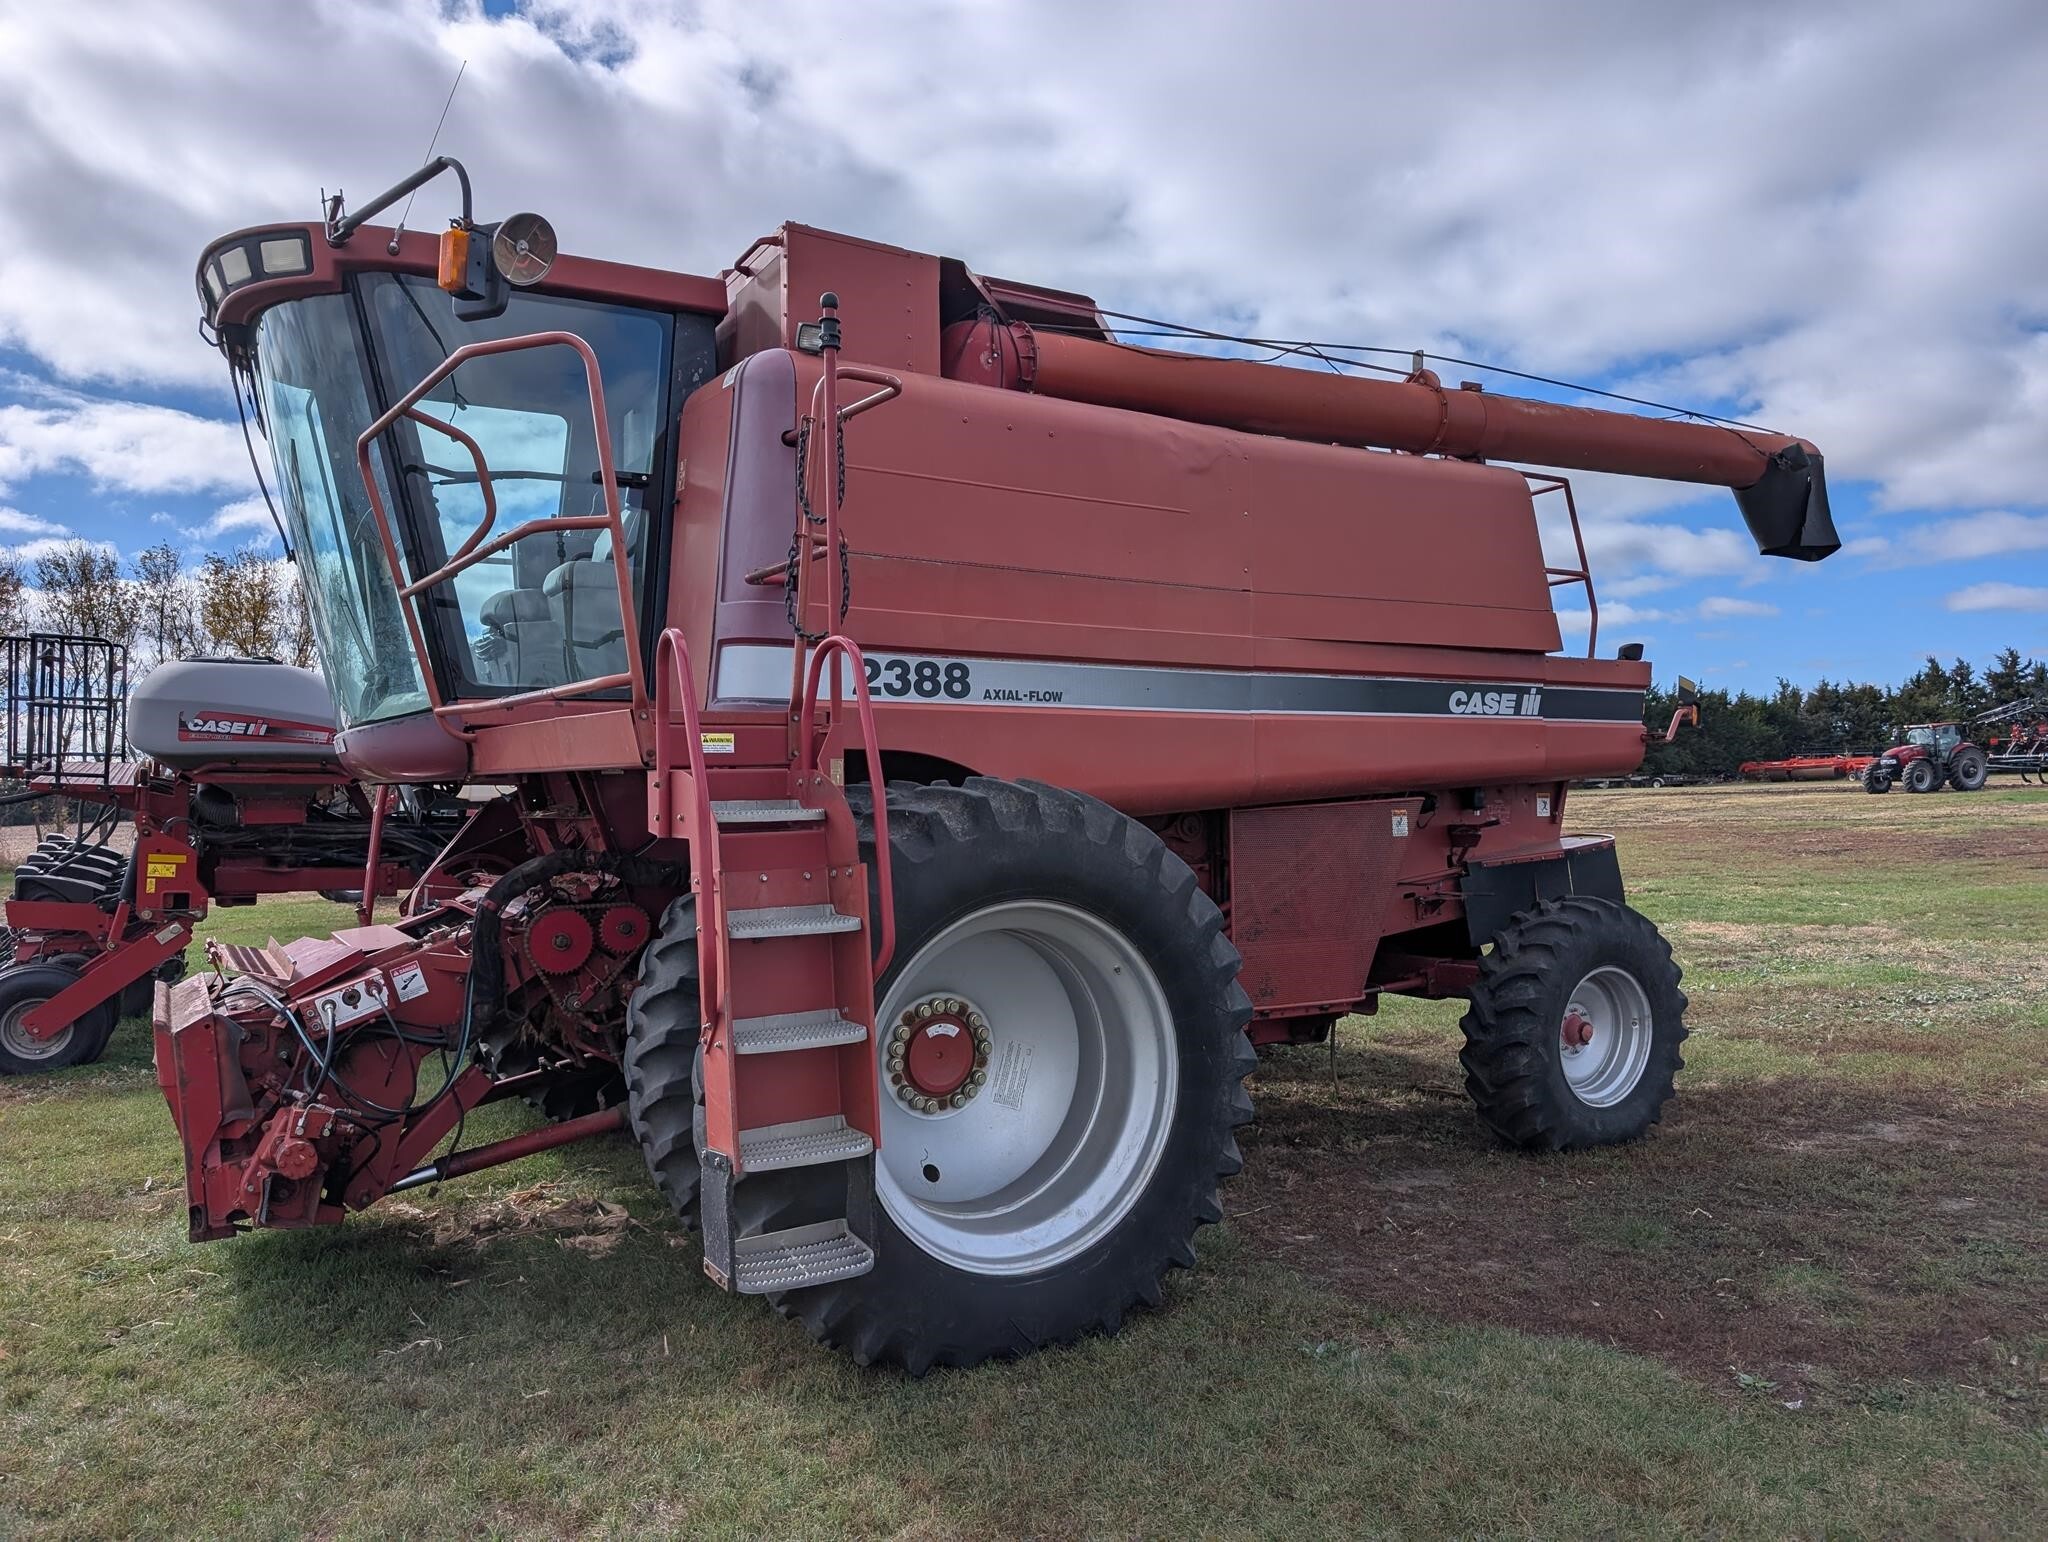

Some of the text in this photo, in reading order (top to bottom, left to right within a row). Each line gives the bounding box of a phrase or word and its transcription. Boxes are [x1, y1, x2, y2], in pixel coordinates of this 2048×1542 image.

[853, 658, 1063, 702] 2388 AXIAL-FLOW
[1448, 690, 1517, 715] CASE
[187, 718, 247, 735] CASE
